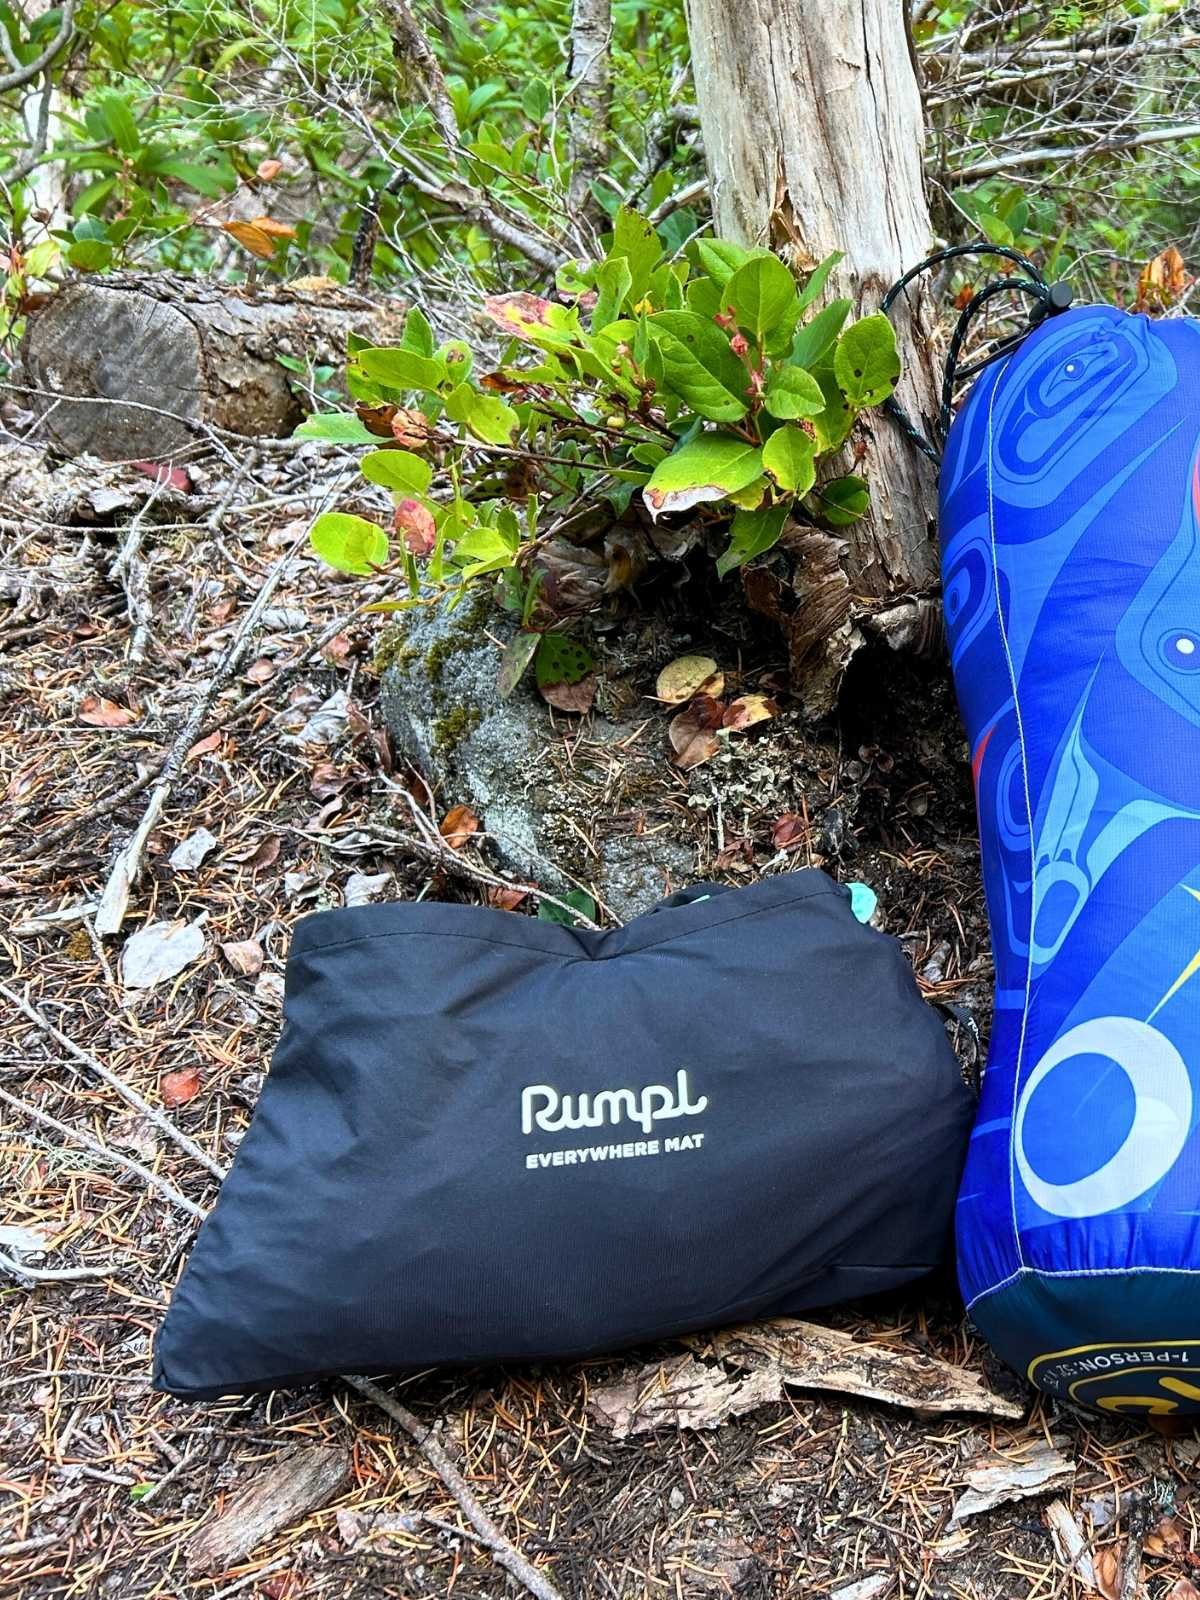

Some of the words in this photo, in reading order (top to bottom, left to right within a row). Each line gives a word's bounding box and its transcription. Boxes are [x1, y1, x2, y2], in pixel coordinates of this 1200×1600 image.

[521, 1069, 708, 1135] Rumpl
[526, 1140, 659, 1169] EVERYWHERE
[664, 1133, 705, 1153] MAT
[1073, 1351, 1189, 1372] 1-PERSON:
